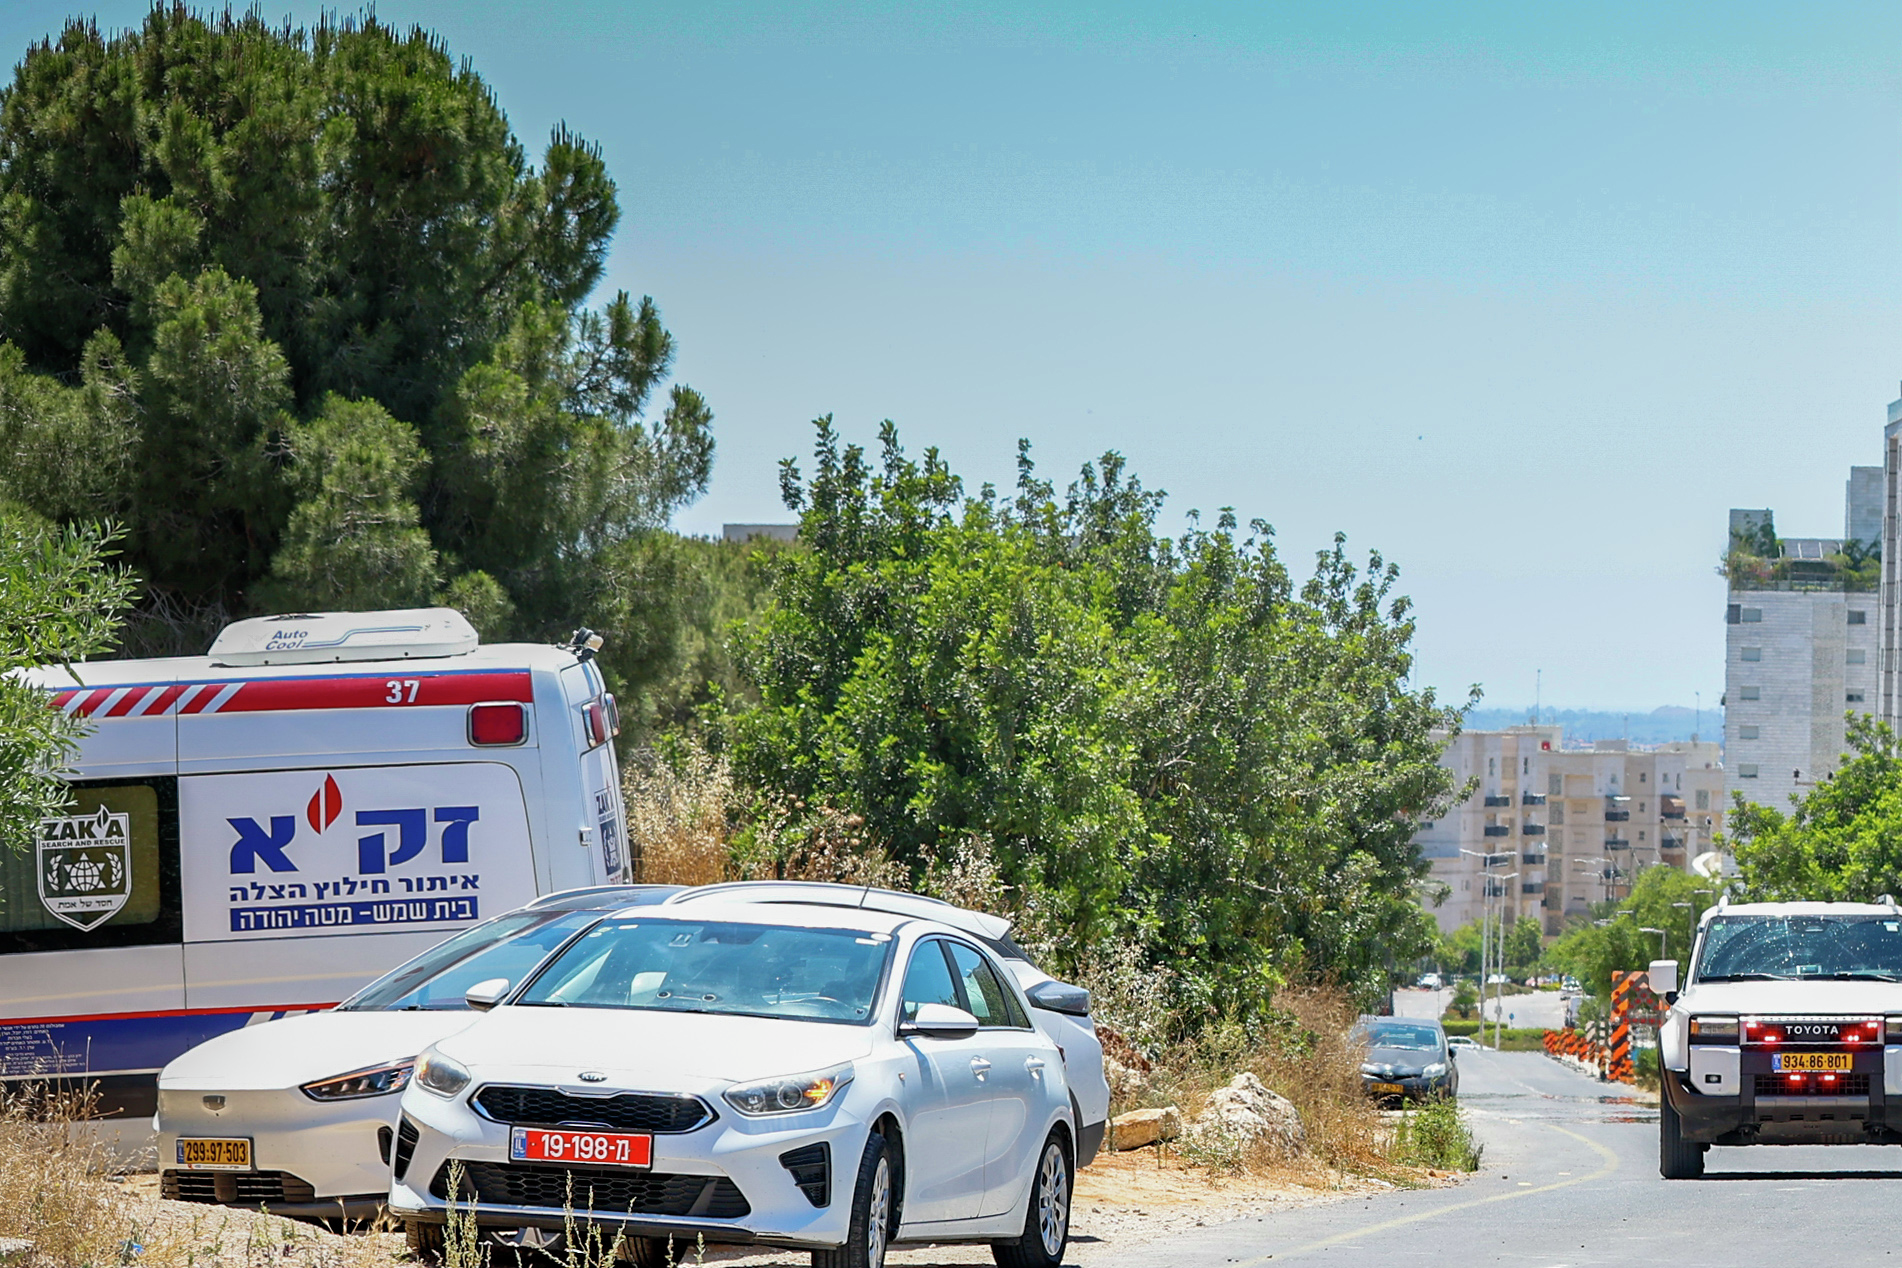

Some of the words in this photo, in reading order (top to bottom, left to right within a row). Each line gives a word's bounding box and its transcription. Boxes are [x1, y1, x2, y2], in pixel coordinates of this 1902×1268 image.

[265, 639, 303, 650] Cool
[272, 630, 308, 640] Auto
[385, 680, 420, 704] 37
[229, 881, 307, 902] הצלה
[312, 877, 390, 900] חילוץ
[398, 874, 480, 893] איתור
[58, 901, 77, 909] אמת
[79, 898, 93, 908] של
[433, 900, 473, 919] בית
[240, 910, 299, 929] יהודה
[305, 906, 351, 926] מטה
[1785, 1025, 1839, 1035] TOYOTA
